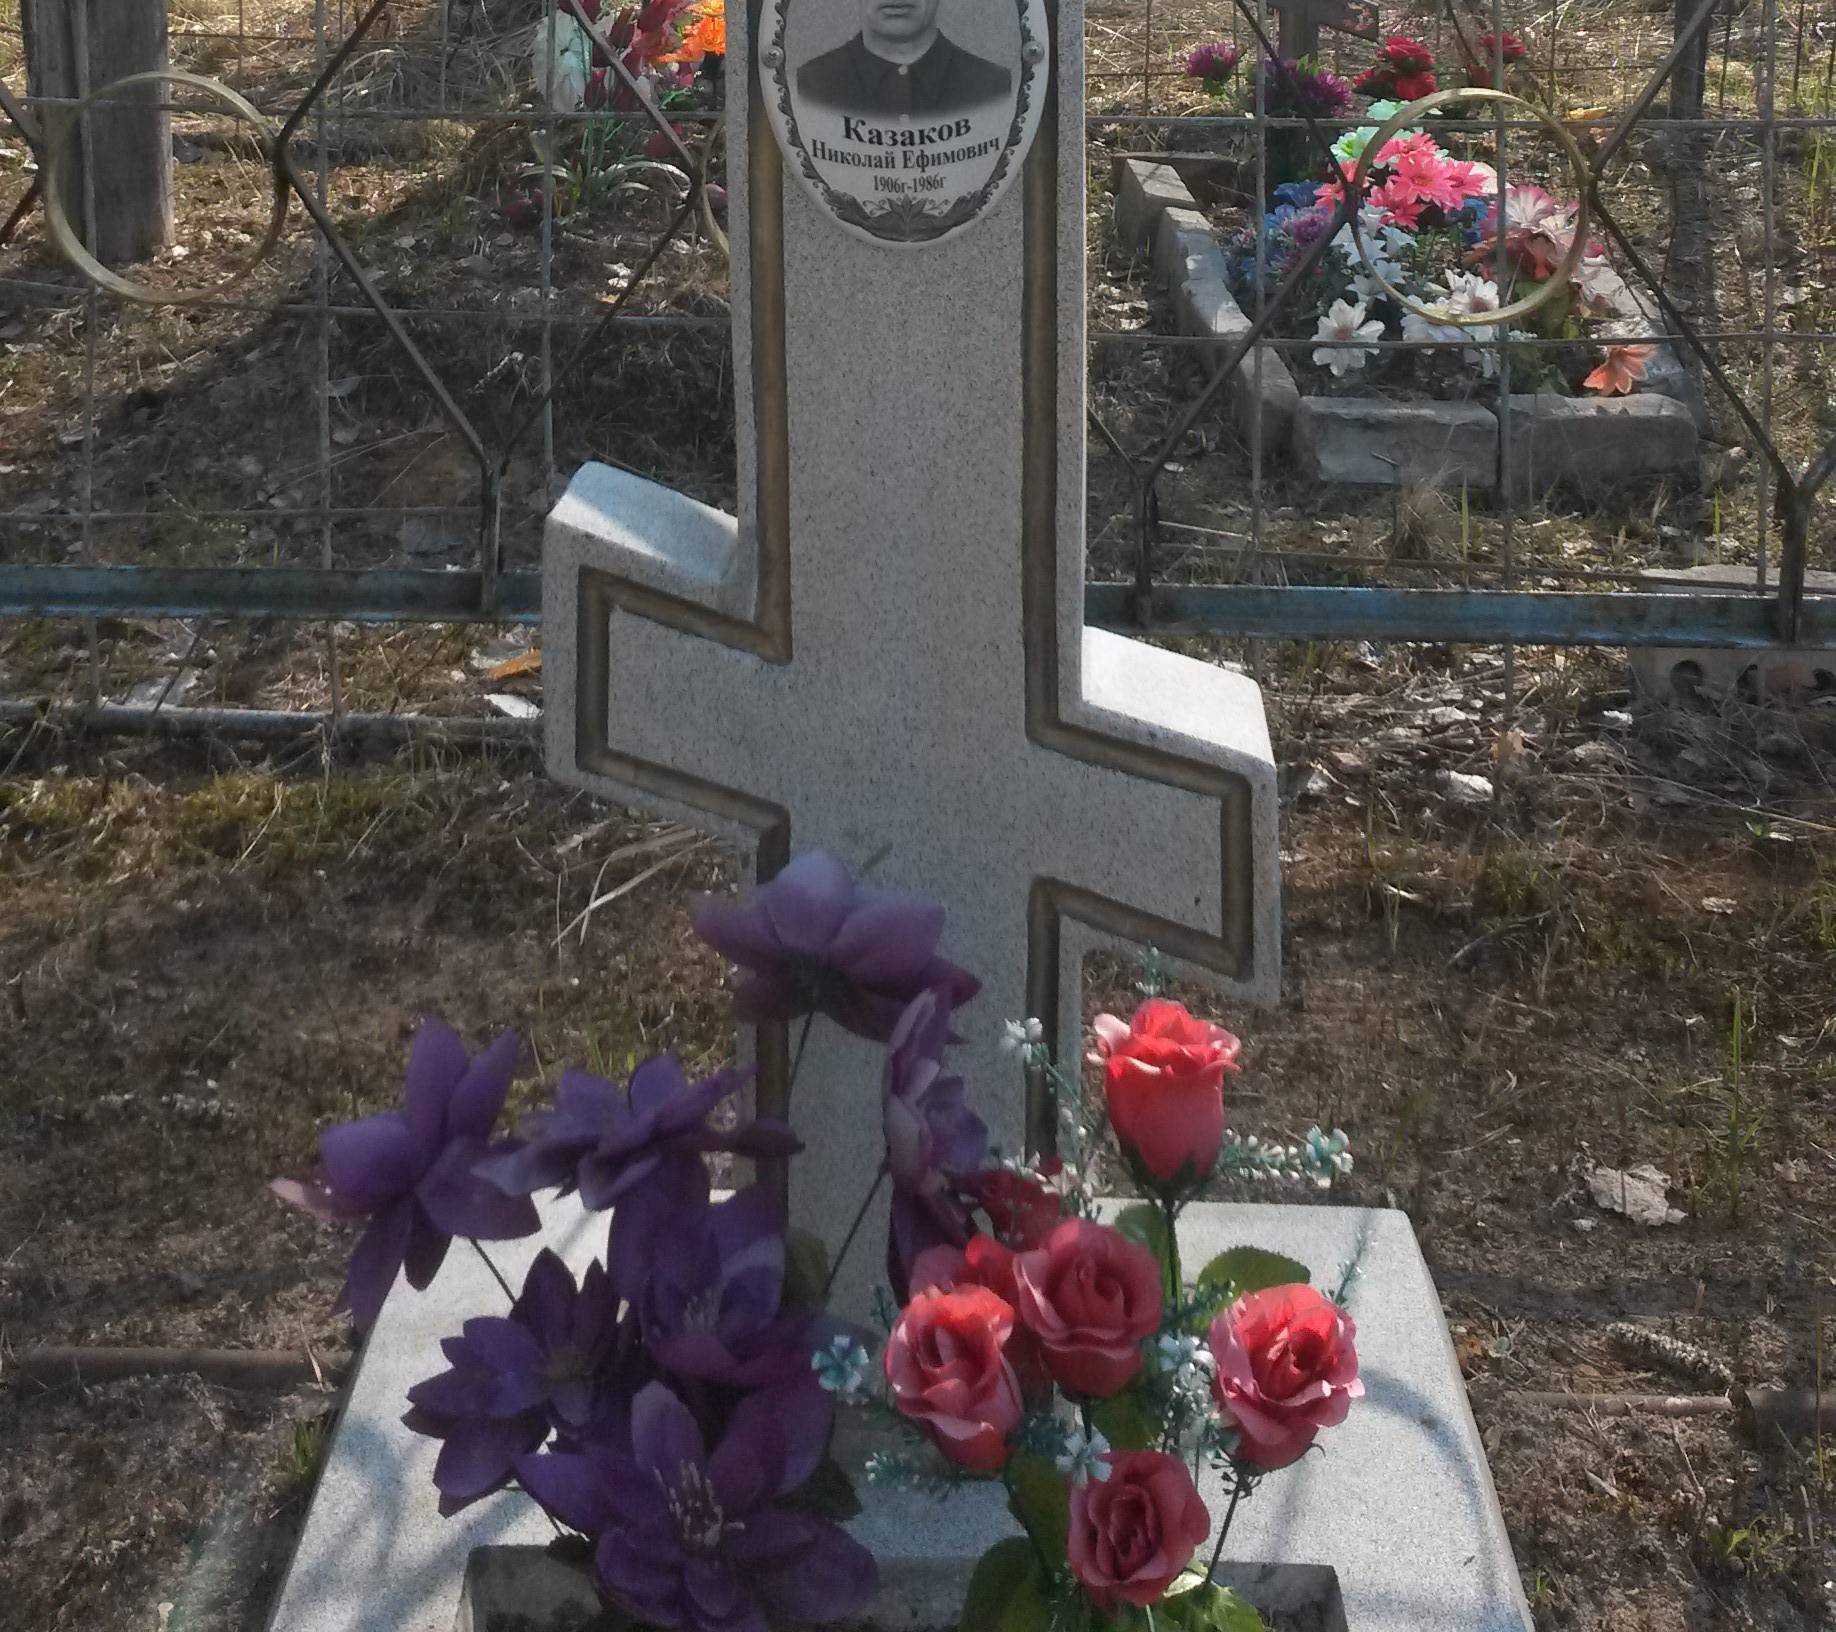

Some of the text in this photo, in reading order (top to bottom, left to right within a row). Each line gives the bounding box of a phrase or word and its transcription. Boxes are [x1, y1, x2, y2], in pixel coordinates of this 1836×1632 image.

[843, 115, 972, 147] Казаков
[812, 137, 1000, 173] Николай Ефимович
[873, 174, 947, 194] 1906г-1986г
